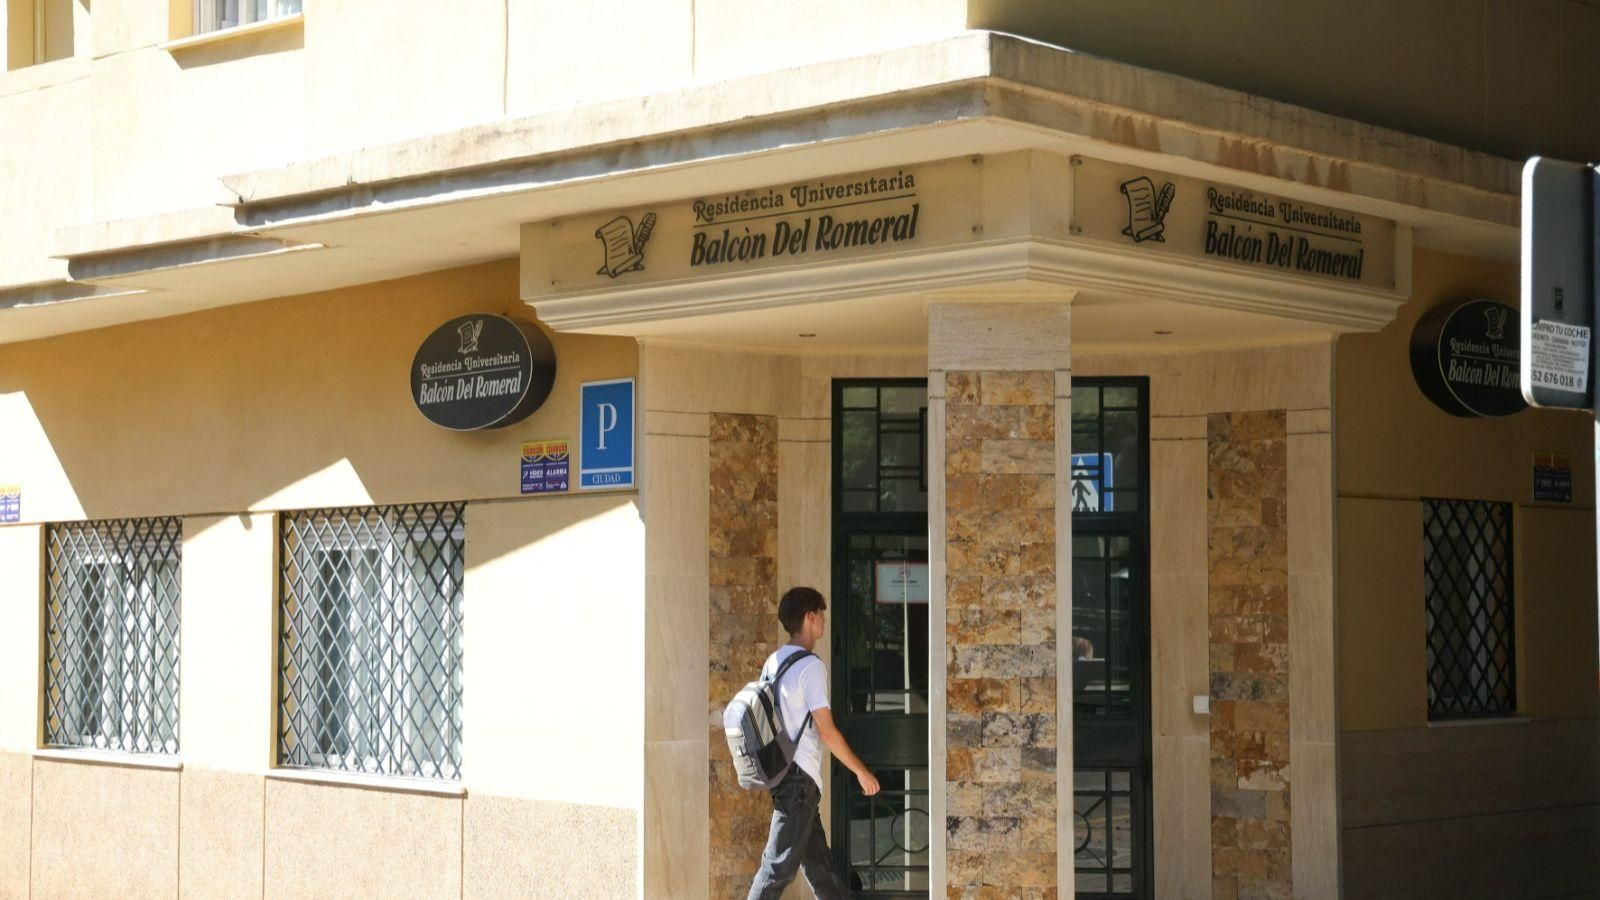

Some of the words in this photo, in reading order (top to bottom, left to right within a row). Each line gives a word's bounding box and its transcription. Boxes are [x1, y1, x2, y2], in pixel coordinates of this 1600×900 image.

[693, 191, 784, 222] Residencia
[791, 170, 915, 207] Universitaria
[1207, 187, 1276, 218] Residencia
[1280, 201, 1361, 234] Universitaria
[772, 217, 811, 257] Del
[815, 203, 920, 251] Romeral
[1205, 221, 1262, 263] Balcón
[1266, 232, 1294, 268] Del
[1296, 238, 1364, 280] Romeral
[1555, 325, 1563, 335] TU
[1564, 327, 1588, 339] COCHE
[1449, 338, 1490, 354] Residencia
[421, 359, 462, 378] Residencia
[464, 352, 520, 371] Universitaria
[1484, 363, 1500, 386] Del
[420, 379, 454, 405] Balcón
[456, 377, 475, 401] Del
[475, 371, 522, 398] Romeral
[1532, 370, 1542, 382] 52
[1544, 372, 1559, 384] 676
[1560, 374, 1574, 387] 018
[596, 403, 618, 450] P
[546, 468, 567, 476] ALARMA
[592, 473, 621, 484] CIUDAD
